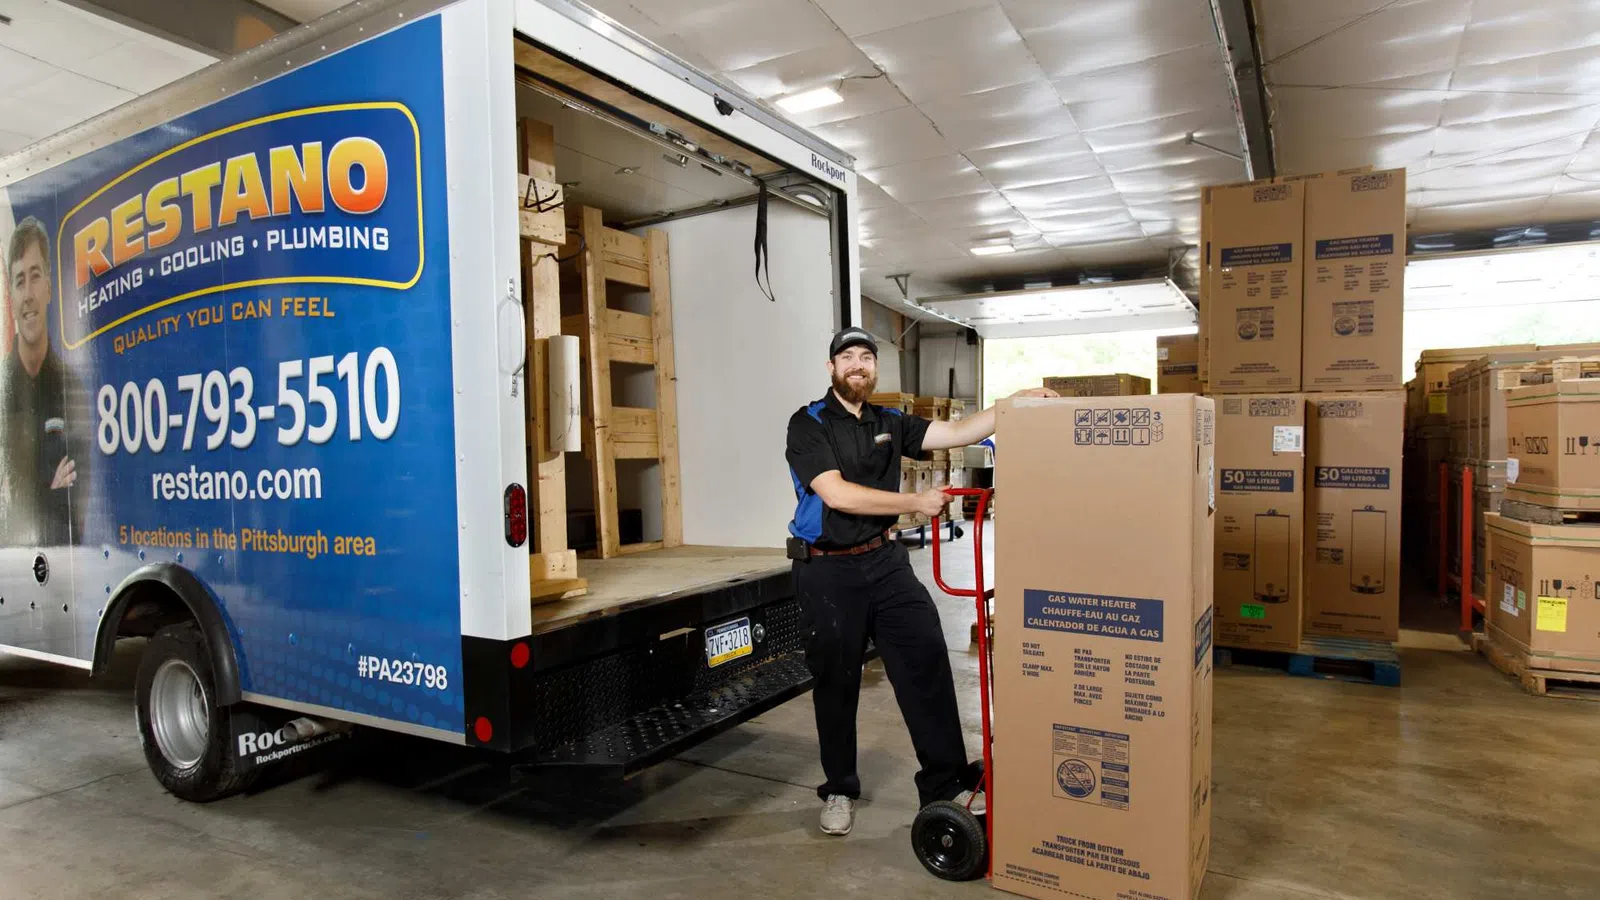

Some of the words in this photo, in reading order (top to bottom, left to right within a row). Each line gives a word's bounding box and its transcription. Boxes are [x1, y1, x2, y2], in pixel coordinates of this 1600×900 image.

[811, 153, 846, 183] Rockport
[74, 136, 389, 289] RESTANO
[77, 268, 144, 318] HEATING
[160, 235, 245, 277] COOLING
[266, 225, 389, 252] PLUMBING
[113, 313, 182, 356] QUALITY
[187, 306, 224, 328] YOU
[231, 299, 272, 321] CAN
[281, 296, 335, 318] FEEL
[97, 346, 401, 455] 800-793-5510
[1153, 411, 1161, 420] 3
[152, 464, 323, 501] restano.com
[1224, 470, 1245, 484] 50
[1318, 468, 1340, 481] 50
[119, 525, 128, 545] 5
[130, 525, 193, 549] locations
[196, 527, 209, 549] in
[212, 527, 237, 551] the
[241, 528, 329, 560] Pittsburgh
[333, 535, 377, 557] area
[1048, 594, 1066, 604] GAS
[1068, 596, 1099, 606] WATER
[1101, 599, 1137, 610] HEATER
[1042, 606, 1103, 619] CHAUFFE-EAU
[1105, 612, 1118, 621] AU
[1121, 613, 1141, 624] GAZ
[1027, 617, 1085, 630] CALENTADOR
[1086, 623, 1099, 632] DE
[1101, 625, 1128, 636] AGUA
[1130, 628, 1137, 636] A
[1139, 628, 1160, 638] GAS
[1023, 649, 1045, 657] TAILGATE
[1074, 655, 1111, 665] TRANSPORTER
[357, 655, 449, 690] #PA23798
[1125, 662, 1149, 670] COSTADO
[1125, 677, 1155, 686] POSTERIOR
[1074, 697, 1092, 706] PINCES
[1088, 692, 1103, 700] AVEC
[1125, 692, 1145, 700] SUJETE
[1145, 694, 1162, 702] COMO
[1125, 706, 1151, 715] UNIDADES
[1125, 714, 1143, 722] ANCHO
[238, 727, 287, 757] Roc
[256, 732, 341, 765] Rockporttrucks.com
[1041, 840, 1086, 857] TRANSPORTER
[1086, 851, 1099, 860] PAR
[1100, 853, 1110, 862] EN
[1111, 855, 1140, 869] DESSOUS
[1056, 834, 1077, 846] TRUCK
[1078, 840, 1096, 850] FROM
[1097, 844, 1124, 856] BOTTOM
[1031, 847, 1065, 861] ACARREAR
[1065, 854, 1085, 866] DESDE
[1086, 860, 1096, 868] LA
[1096, 862, 1116, 873] PARTE
[1117, 866, 1127, 875] DE
[1128, 868, 1150, 880] ABAJO
